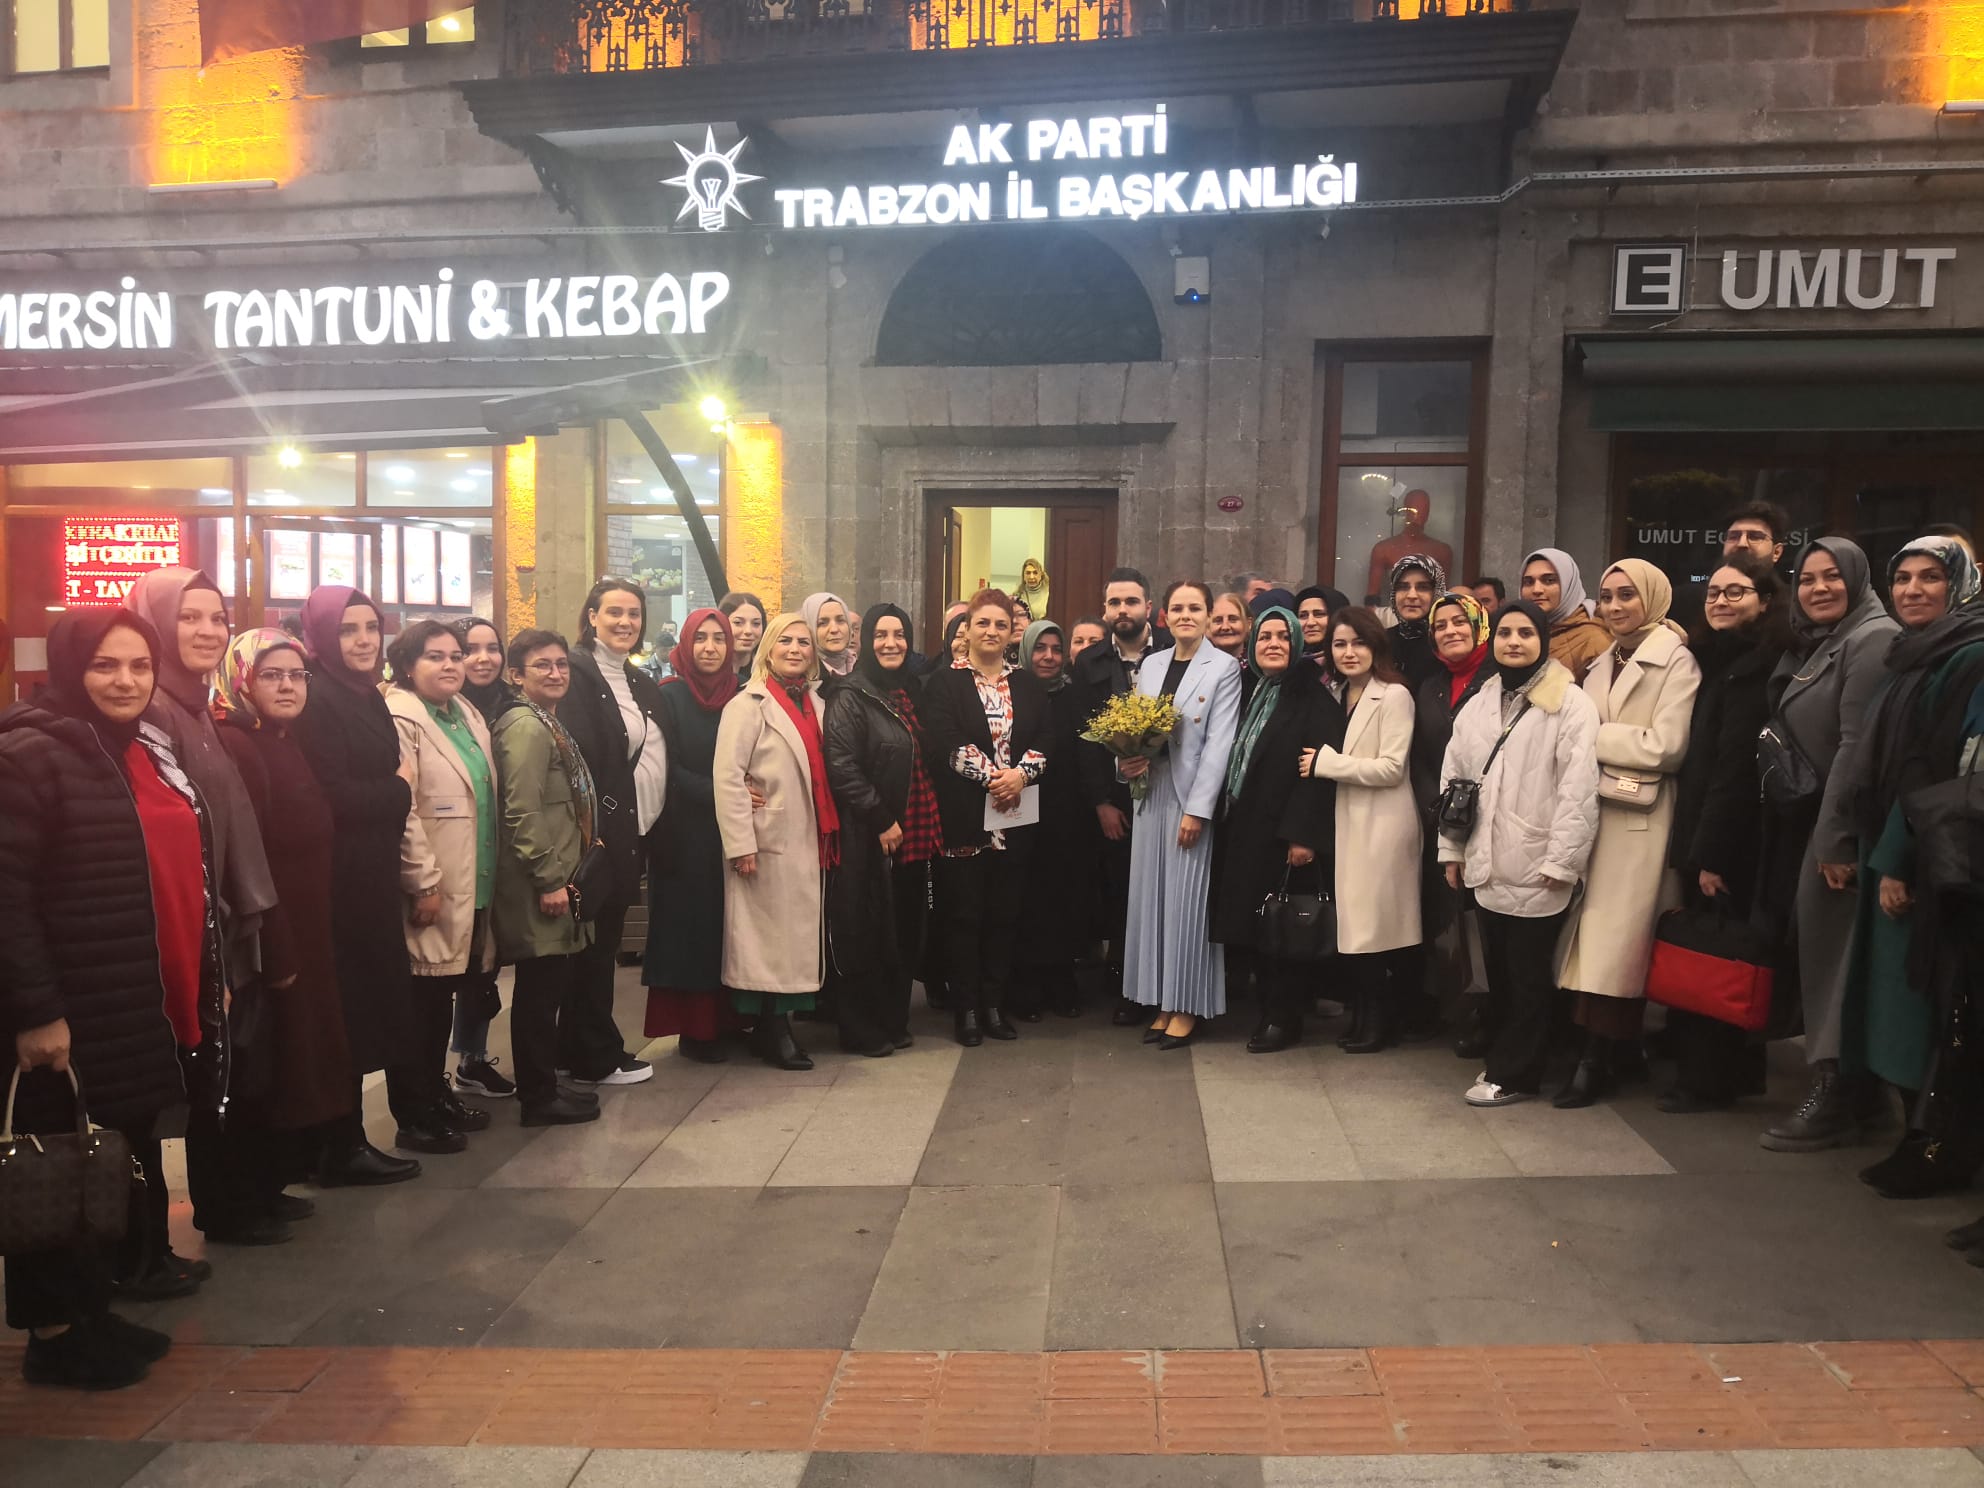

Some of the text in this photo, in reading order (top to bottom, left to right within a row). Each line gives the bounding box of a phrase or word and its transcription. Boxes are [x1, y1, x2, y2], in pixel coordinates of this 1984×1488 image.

[943, 103, 1167, 166] AK PARTİ
[774, 154, 1358, 229] TRABZON İL BAŞKANLIĞI
[204, 267, 454, 349] TANTUNİ
[467, 279, 513, 340] &
[525, 271, 730, 338] KEBAP
[1720, 247, 1957, 310] UMUT
[1638, 529, 1697, 544] UMUT
